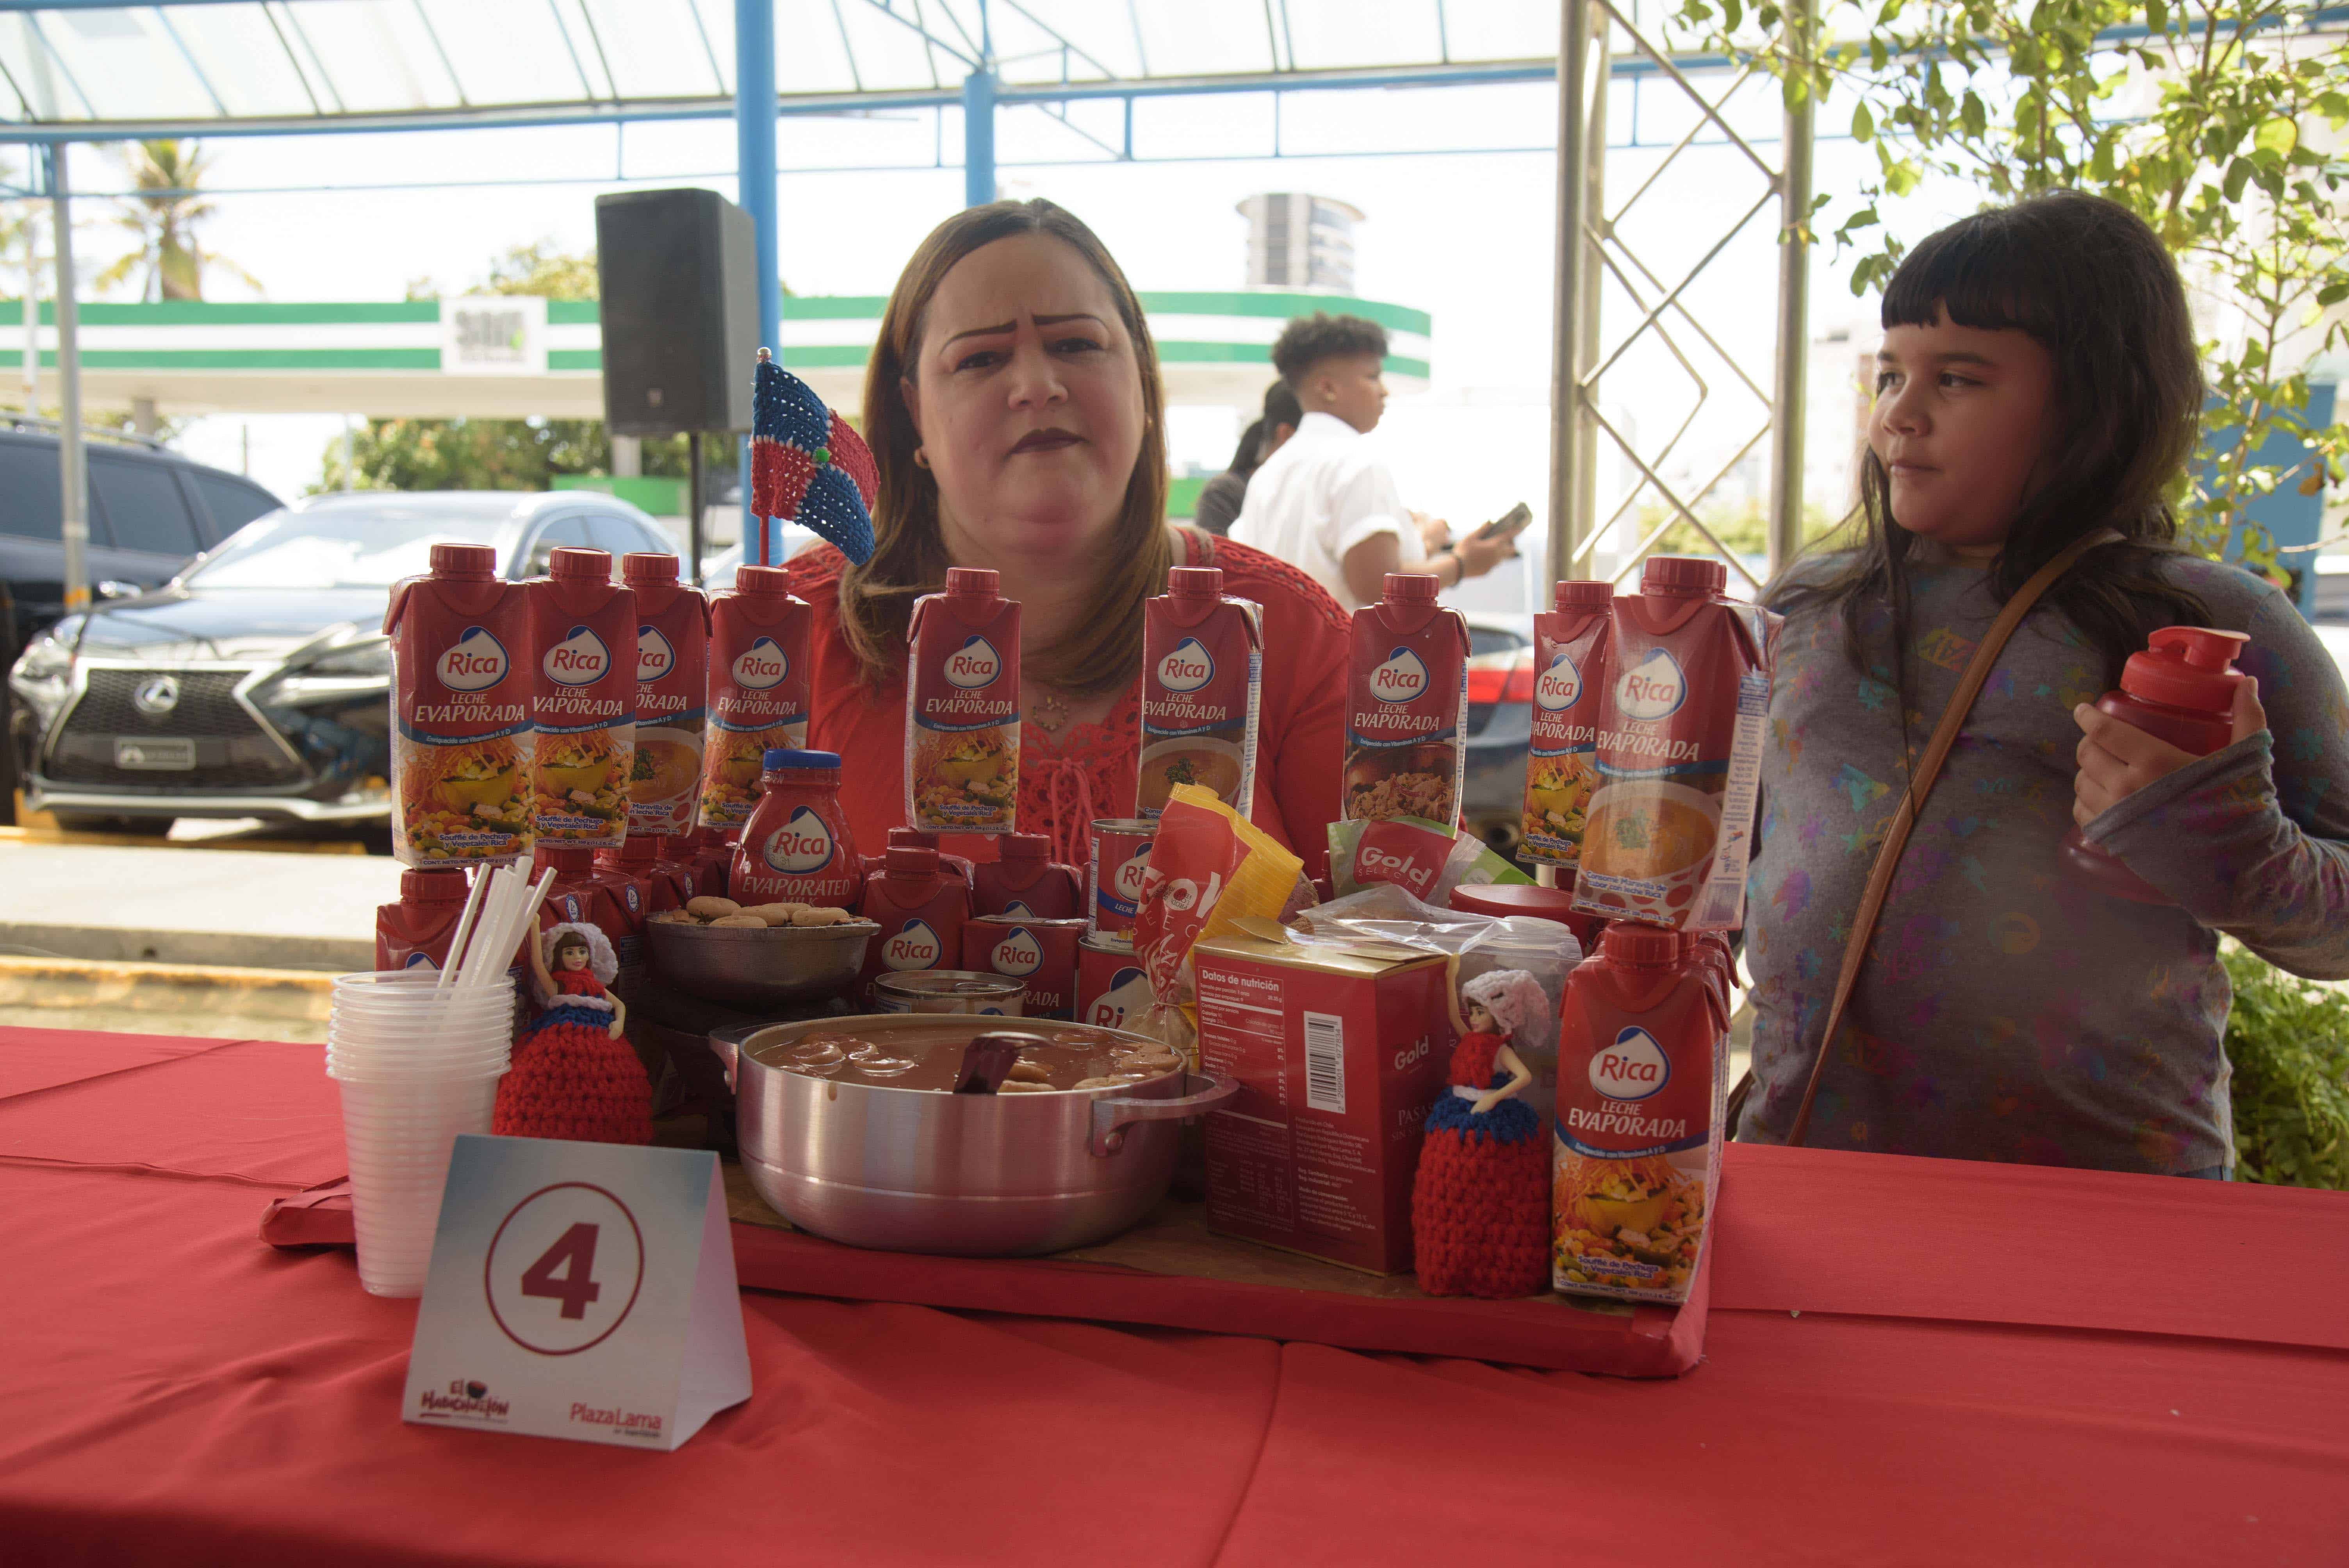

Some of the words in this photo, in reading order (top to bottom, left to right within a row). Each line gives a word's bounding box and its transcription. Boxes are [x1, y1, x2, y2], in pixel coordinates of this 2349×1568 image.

[447, 652, 499, 676] Rica
[552, 649, 601, 671] Rica
[638, 648, 665, 667] ica
[741, 657, 781, 676] Rica
[952, 656, 993, 676] Rica
[1165, 658, 1206, 679] Rica
[1377, 668, 1420, 689] Rica
[1540, 675, 1574, 697] Rica
[555, 687, 589, 697] LECHE
[636, 684, 654, 693] CHE
[742, 691, 770, 700] LECHE
[954, 690, 984, 699] LECHE
[1166, 693, 1194, 703] LECHE
[1624, 674, 1676, 703] Rica
[451, 694, 488, 704] LECHE
[533, 696, 622, 715] VAPORADA
[636, 693, 687, 710] ORADA
[718, 697, 797, 715] EVAPORADA
[925, 699, 1012, 714] EVAPORADA
[415, 704, 525, 722] EVAPORADA
[1143, 701, 1226, 720] EVAPORADA
[1379, 704, 1409, 714] LECHE
[1540, 712, 1563, 723] LECHE
[534, 725, 559, 733] nriquecida
[1355, 713, 1440, 731] EVAPORADA
[1623, 721, 1658, 736] LECHE
[1597, 731, 1700, 762] EVAPORADA
[547, 821, 581, 830] Vegetales
[450, 840, 488, 848] Vegetales
[773, 832, 825, 857] Rica
[1533, 840, 1555, 849] Vegetales
[1550, 837, 1571, 847] Pechuga
[1123, 865, 1145, 887] Ri
[1361, 847, 1433, 886] Gold
[743, 876, 850, 896] EVAPORATED
[1115, 903, 1134, 914] LECHE
[890, 939, 933, 960] Rica
[999, 945, 1036, 964] Rica
[1202, 969, 1226, 983] Datos
[1228, 975, 1239, 985] de
[1241, 977, 1279, 991] nutrición
[1095, 1003, 1125, 1028] Ri
[1394, 1035, 1429, 1070] Gold
[1599, 1054, 1657, 1082] Rica
[1600, 1100, 1643, 1115] LECHE
[1568, 1107, 1687, 1138] EVAPORADA
[521, 1221, 601, 1320] 4
